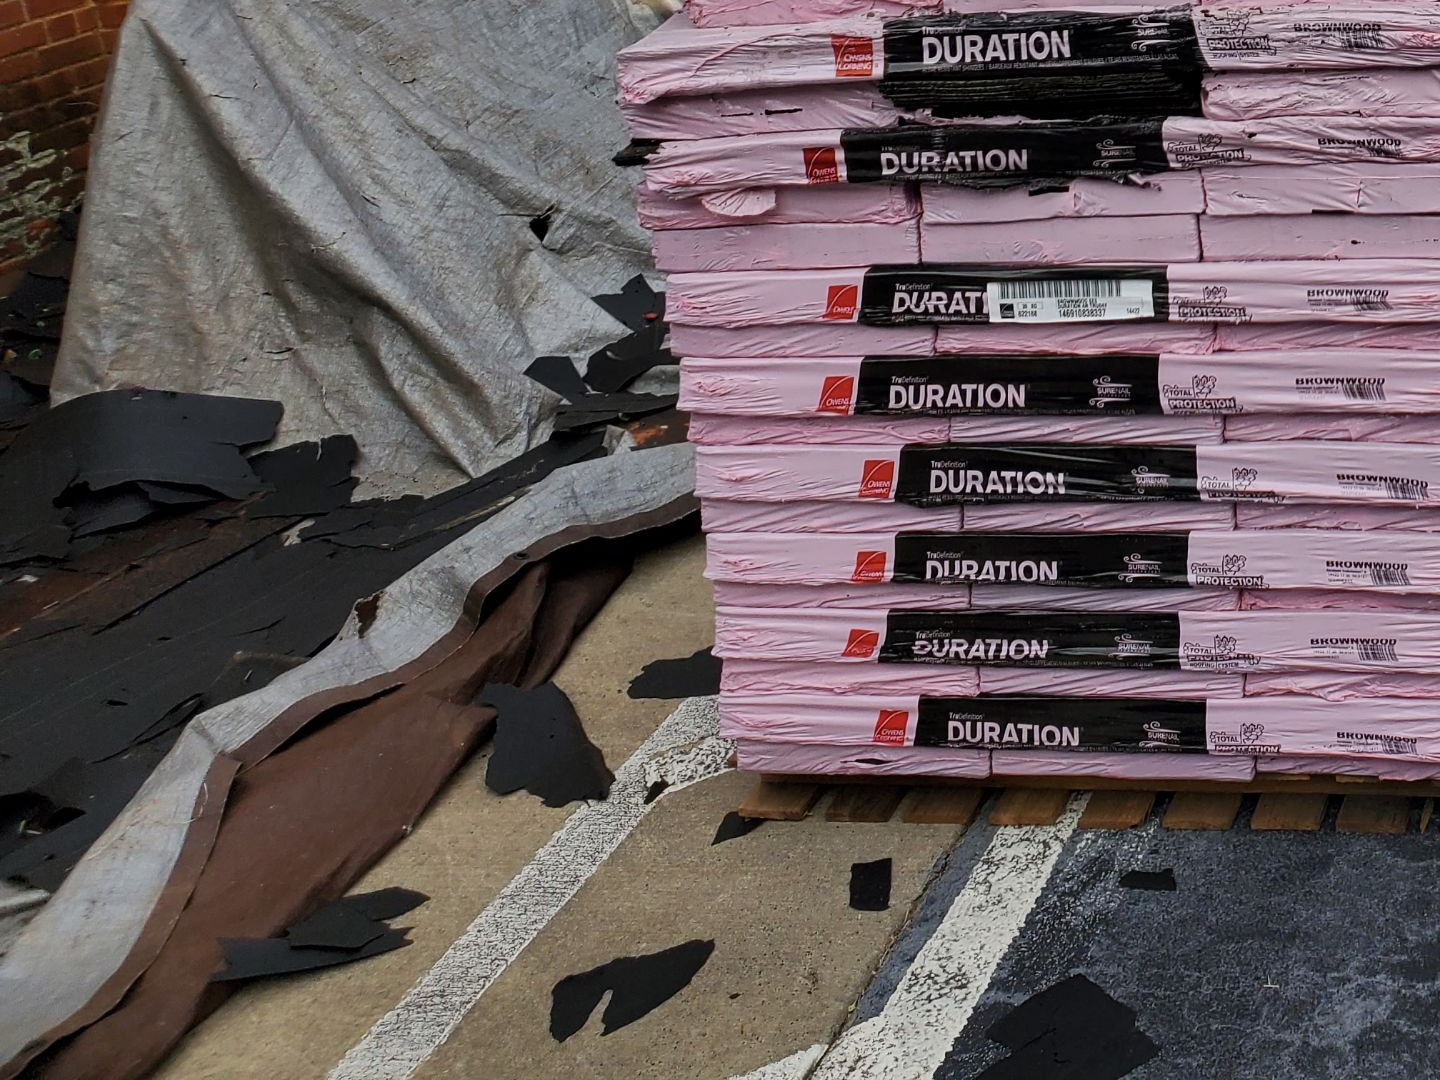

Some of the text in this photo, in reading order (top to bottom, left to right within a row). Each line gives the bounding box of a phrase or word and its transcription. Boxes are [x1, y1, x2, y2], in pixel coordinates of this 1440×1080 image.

[1294, 23, 1382, 32] BROWNWOOD
[922, 29, 1072, 64] DURATION
[881, 149, 1028, 176] DURATION
[1307, 289, 1389, 298] BROWNWOOD
[891, 291, 989, 314] DURATI
[1295, 377, 1386, 386] BROWNWOOD
[1097, 387, 1130, 395] SURENAIL
[1169, 389, 1193, 397] TOTAL
[888, 384, 1027, 410] DURATION
[1169, 398, 1236, 409] PROTECTION
[867, 480, 891, 488] OWENS
[930, 470, 1066, 495] DURATION
[1207, 481, 1231, 489] TOTAL
[1336, 473, 1429, 488] BROWNWOOD
[926, 560, 1058, 582] DURATION
[1326, 560, 1409, 571] BROWNWOOD
[1197, 576, 1262, 587] PROTECTION
[1310, 637, 1397, 646] BROWNWOOD
[912, 638, 1049, 661] DURATION
[1190, 647, 1213, 655] TOTAL
[947, 720, 1080, 747] DURATION
[1216, 735, 1239, 743] TOTAL
[1336, 731, 1418, 744] BROWNWOOD
